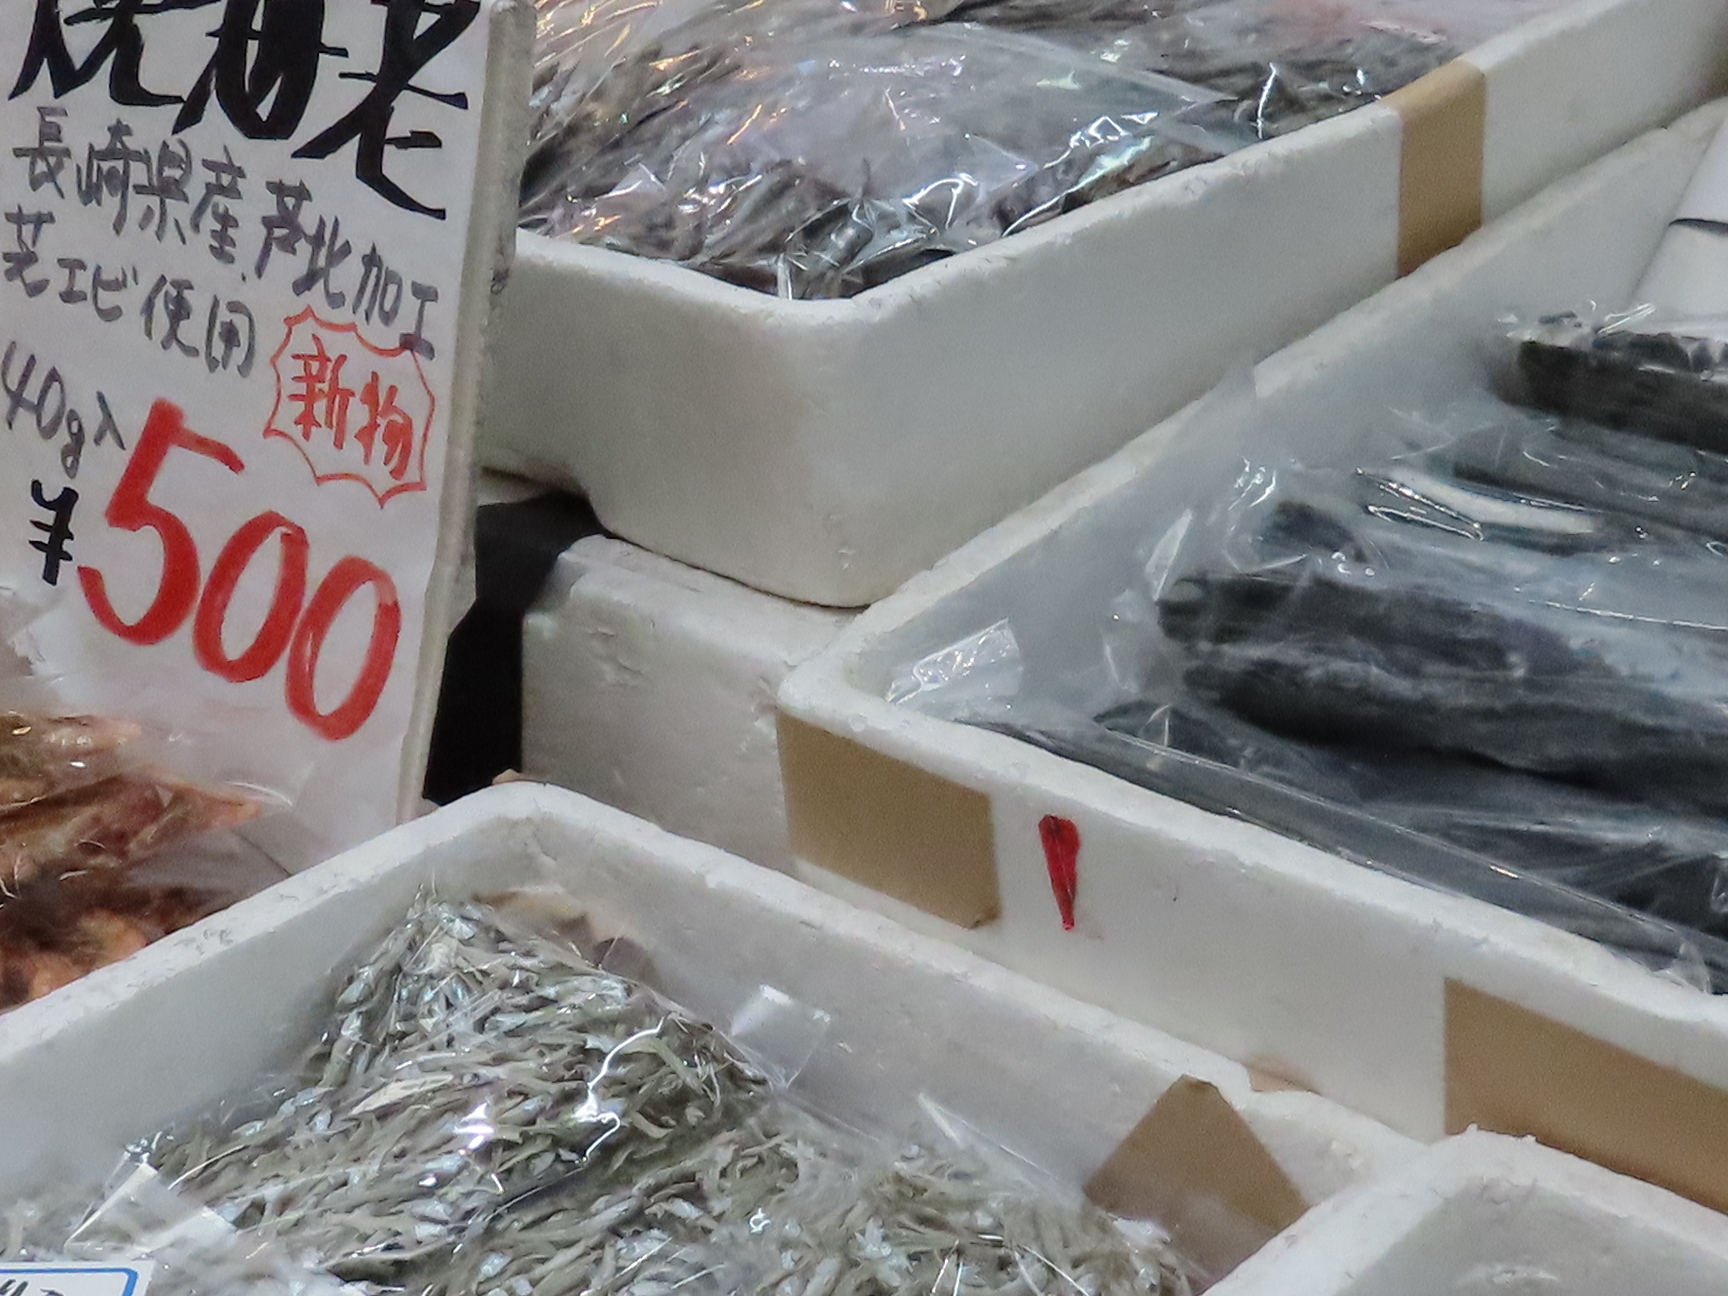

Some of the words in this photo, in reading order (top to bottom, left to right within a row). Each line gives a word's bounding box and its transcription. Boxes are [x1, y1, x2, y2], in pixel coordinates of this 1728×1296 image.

[1, 203, 256, 380] 芝エビ使用
[0, 340, 127, 481] 40g入
[286, 333, 414, 482] 新物
[28, 398, 403, 743] ¥500
